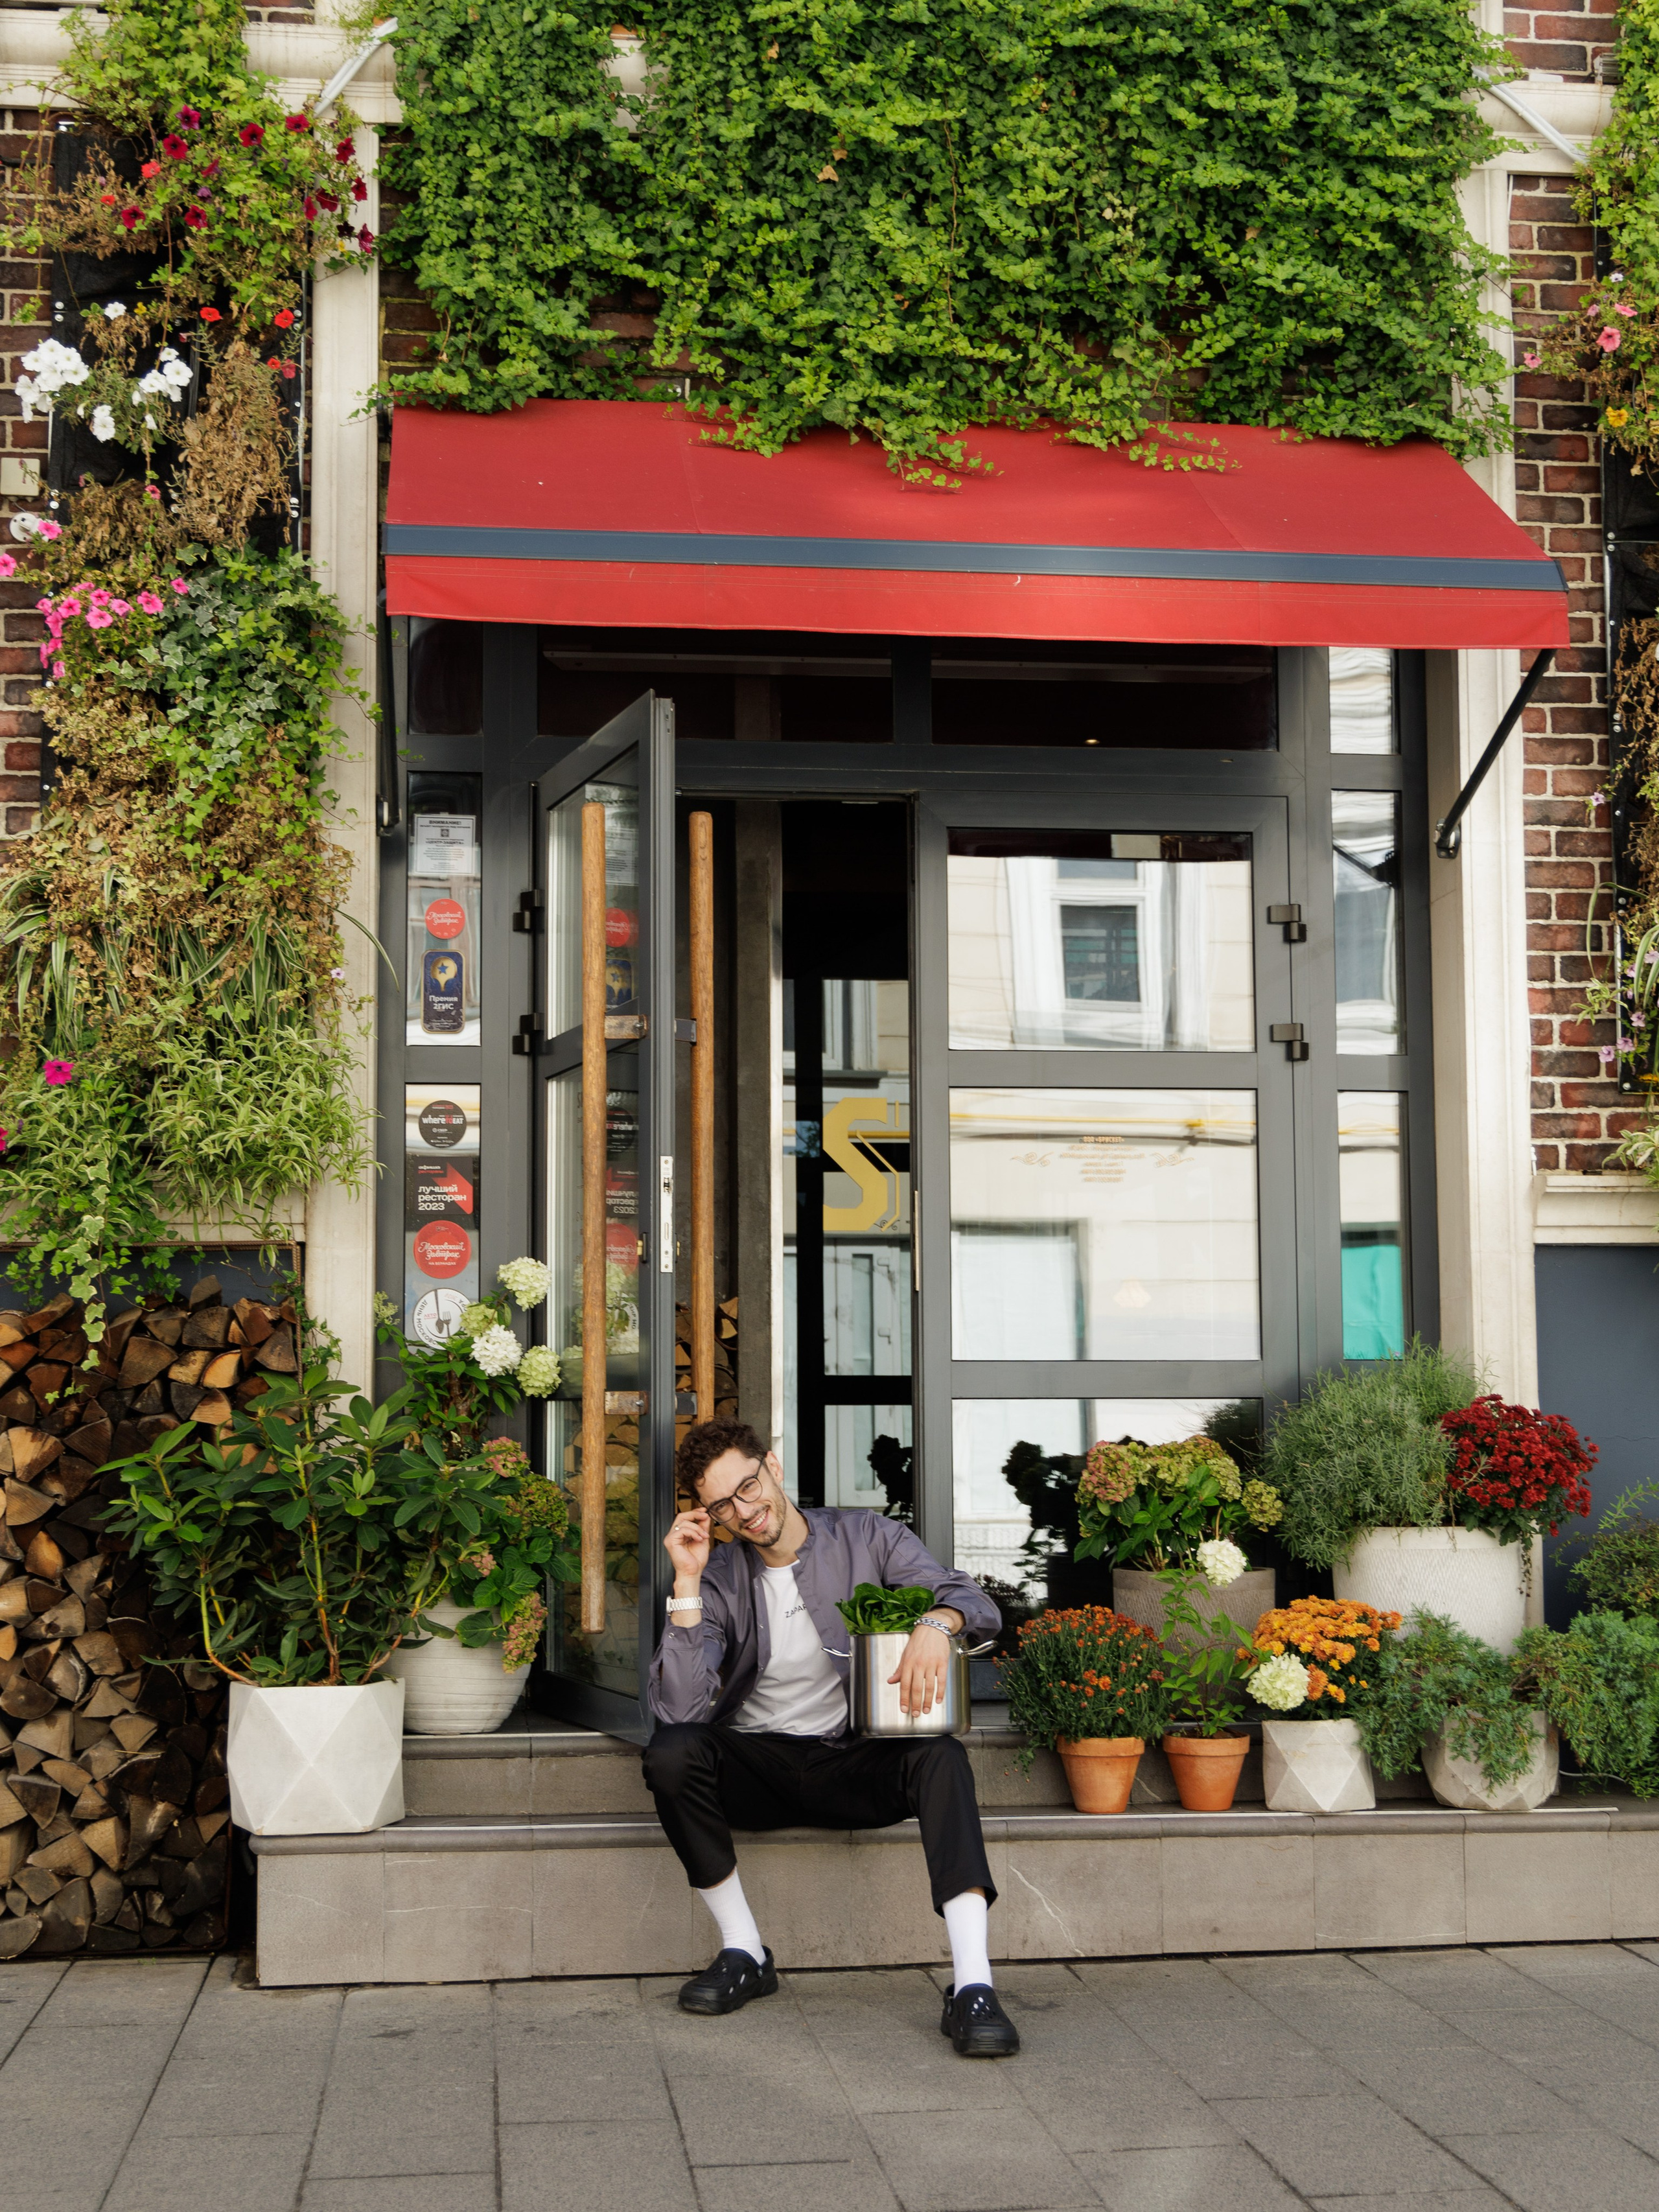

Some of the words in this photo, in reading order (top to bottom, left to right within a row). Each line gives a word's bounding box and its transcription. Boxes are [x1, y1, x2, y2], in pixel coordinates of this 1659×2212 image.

[418, 1184, 458, 1194] лучший
[417, 1241, 466, 1252] Московский
[425, 1249, 461, 1261] Завтрак
